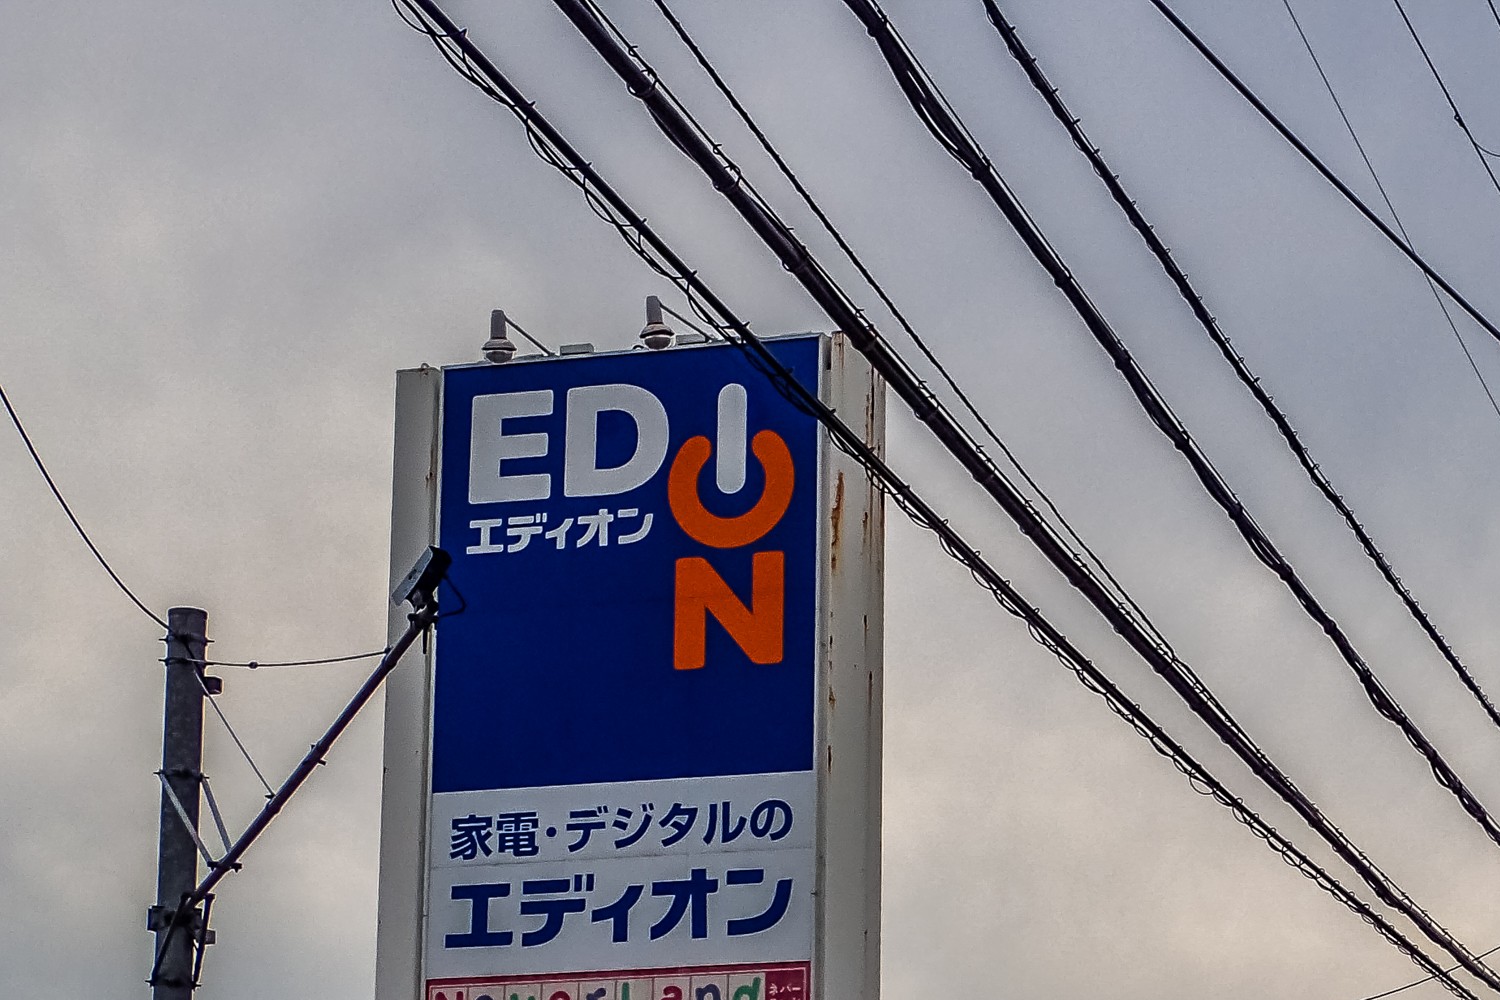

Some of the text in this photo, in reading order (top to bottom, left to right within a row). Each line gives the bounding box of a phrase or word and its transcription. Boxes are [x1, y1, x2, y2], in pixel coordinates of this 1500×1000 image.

[466, 507, 654, 556] エディオン
[448, 798, 795, 861] 家電・デジタルの
[443, 867, 794, 949] エディオン
